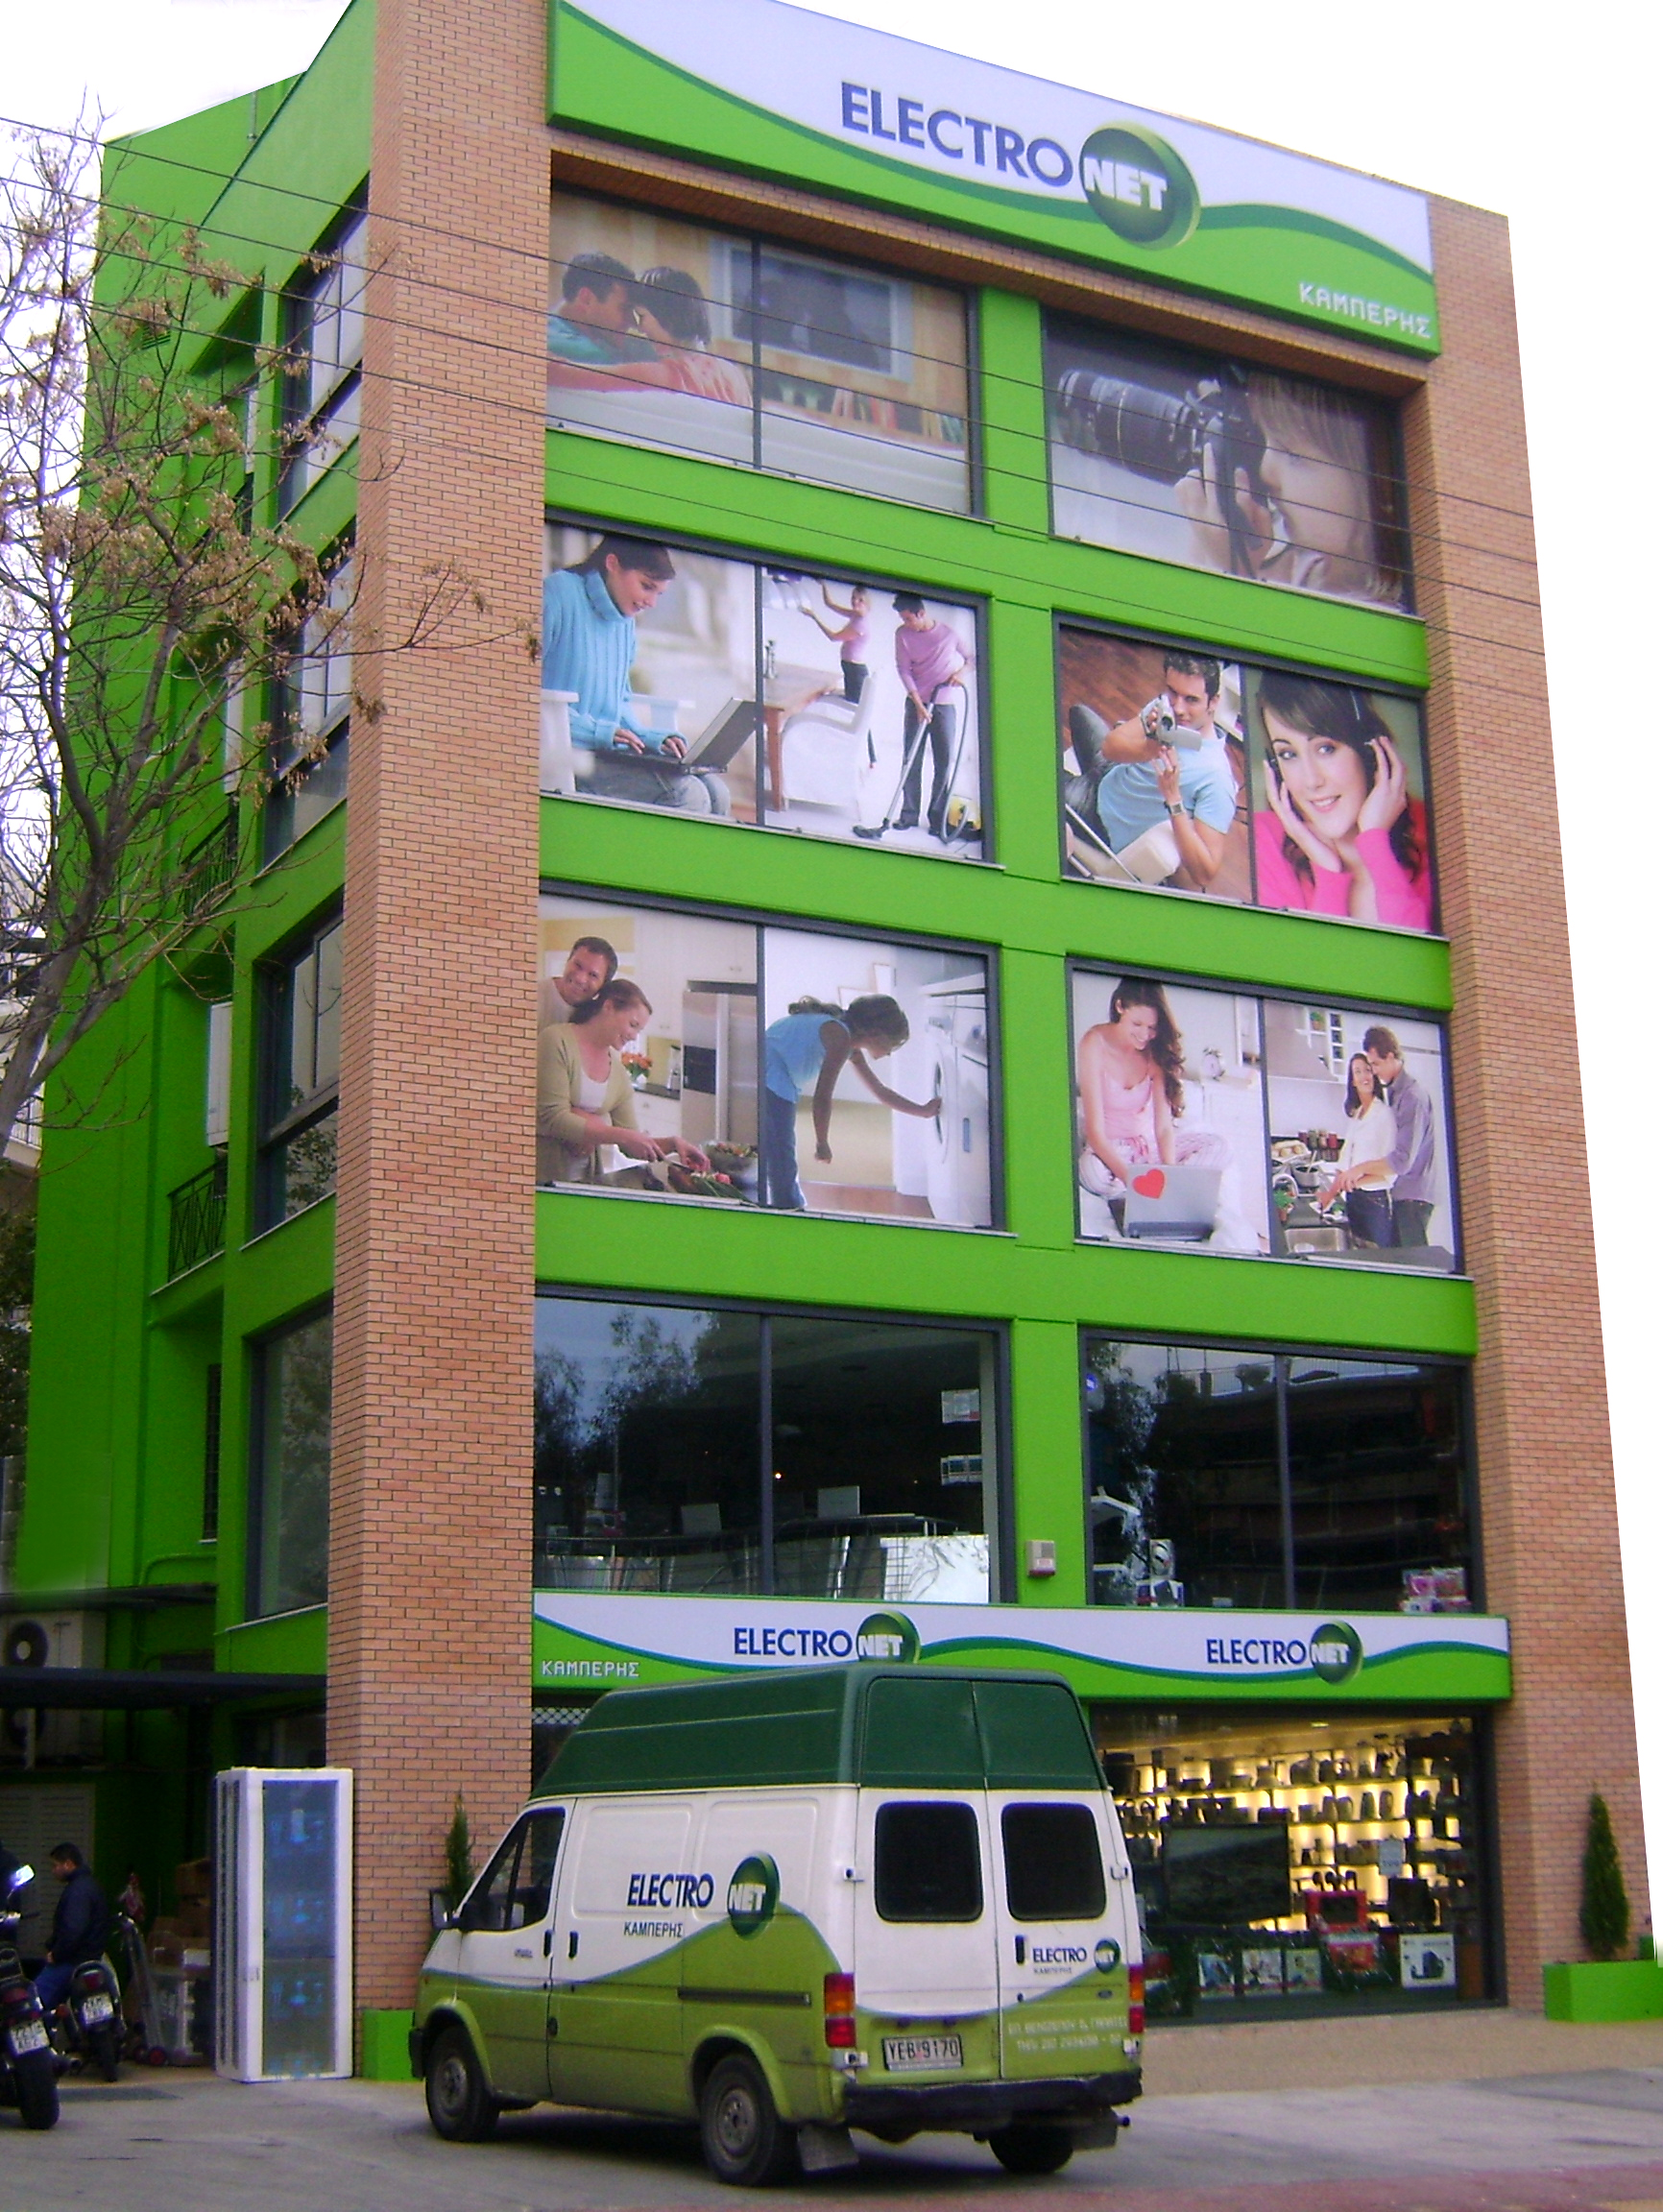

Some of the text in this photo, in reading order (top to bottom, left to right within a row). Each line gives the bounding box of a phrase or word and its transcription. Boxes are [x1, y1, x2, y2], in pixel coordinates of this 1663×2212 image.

[841, 82, 1169, 211] ELECTRO NET
[1299, 282, 1431, 339] ΚΑΜΠΕΡΗΣ
[734, 1627, 904, 1657] ELECTRO NET
[1206, 1639, 1351, 1665] ELECTRO NET
[541, 1660, 640, 1678] ΚΑΜΠΕΡΗΣ
[626, 1873, 766, 1912] ELECTRO NET
[624, 1921, 683, 1937] ΚΑΜΠΕΡΗΣ
[1032, 1947, 1087, 1963] ELECTRO
